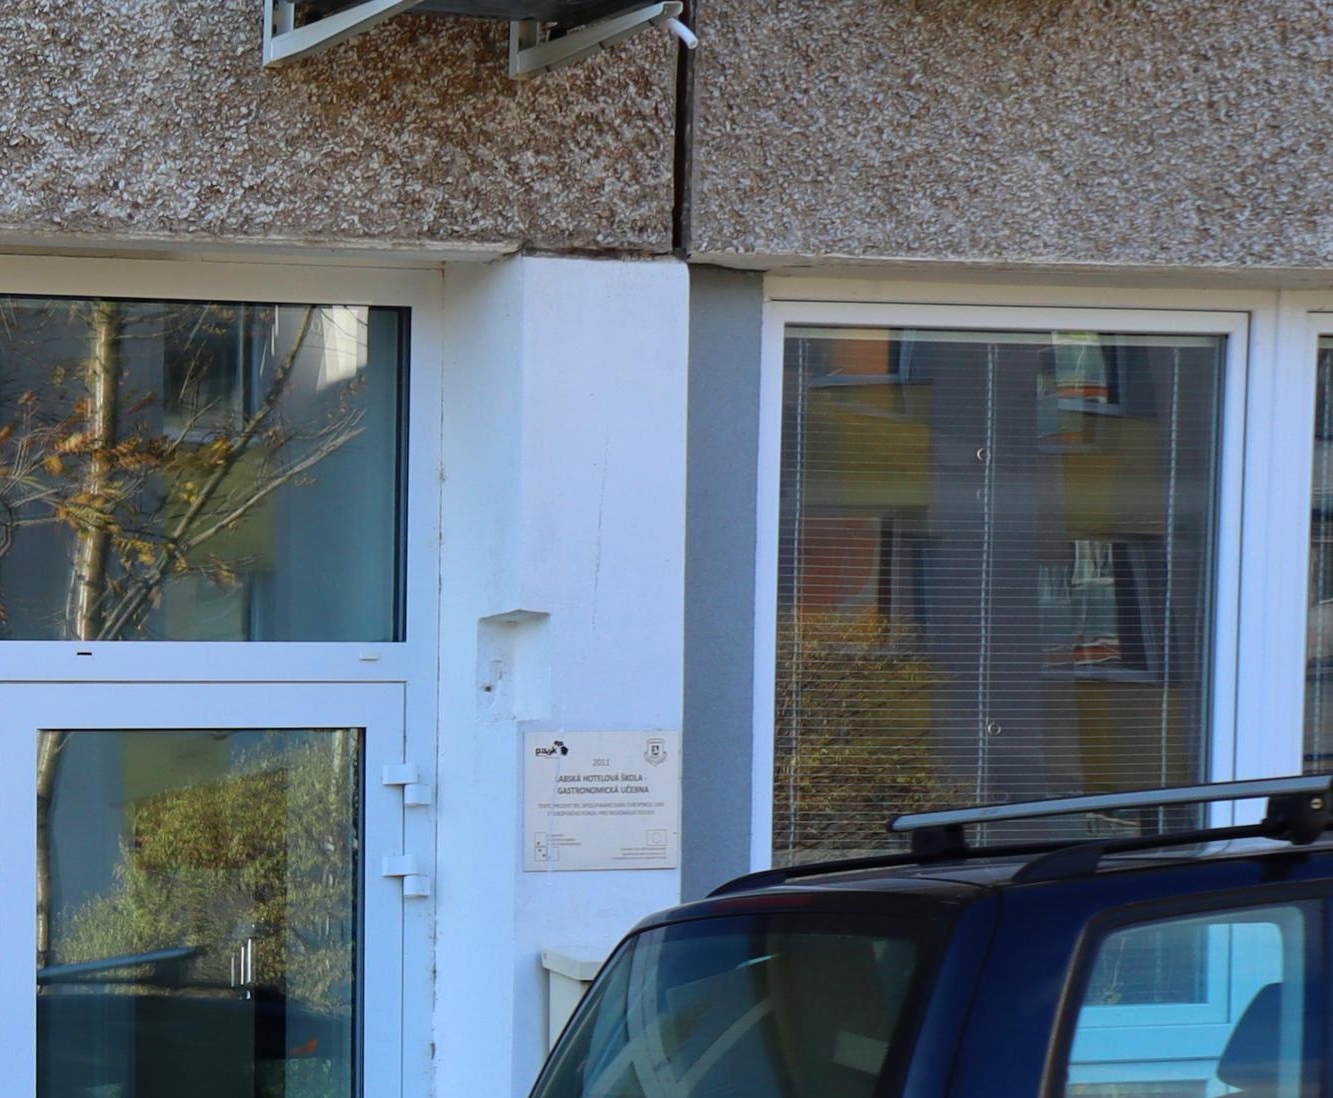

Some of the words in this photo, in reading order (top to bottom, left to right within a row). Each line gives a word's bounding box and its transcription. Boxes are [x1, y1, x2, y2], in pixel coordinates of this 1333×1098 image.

[582, 772, 619, 782] HOTELOVÁ
[620, 771, 643, 782] ŠKOLA
[620, 784, 650, 794] UČEBNA
